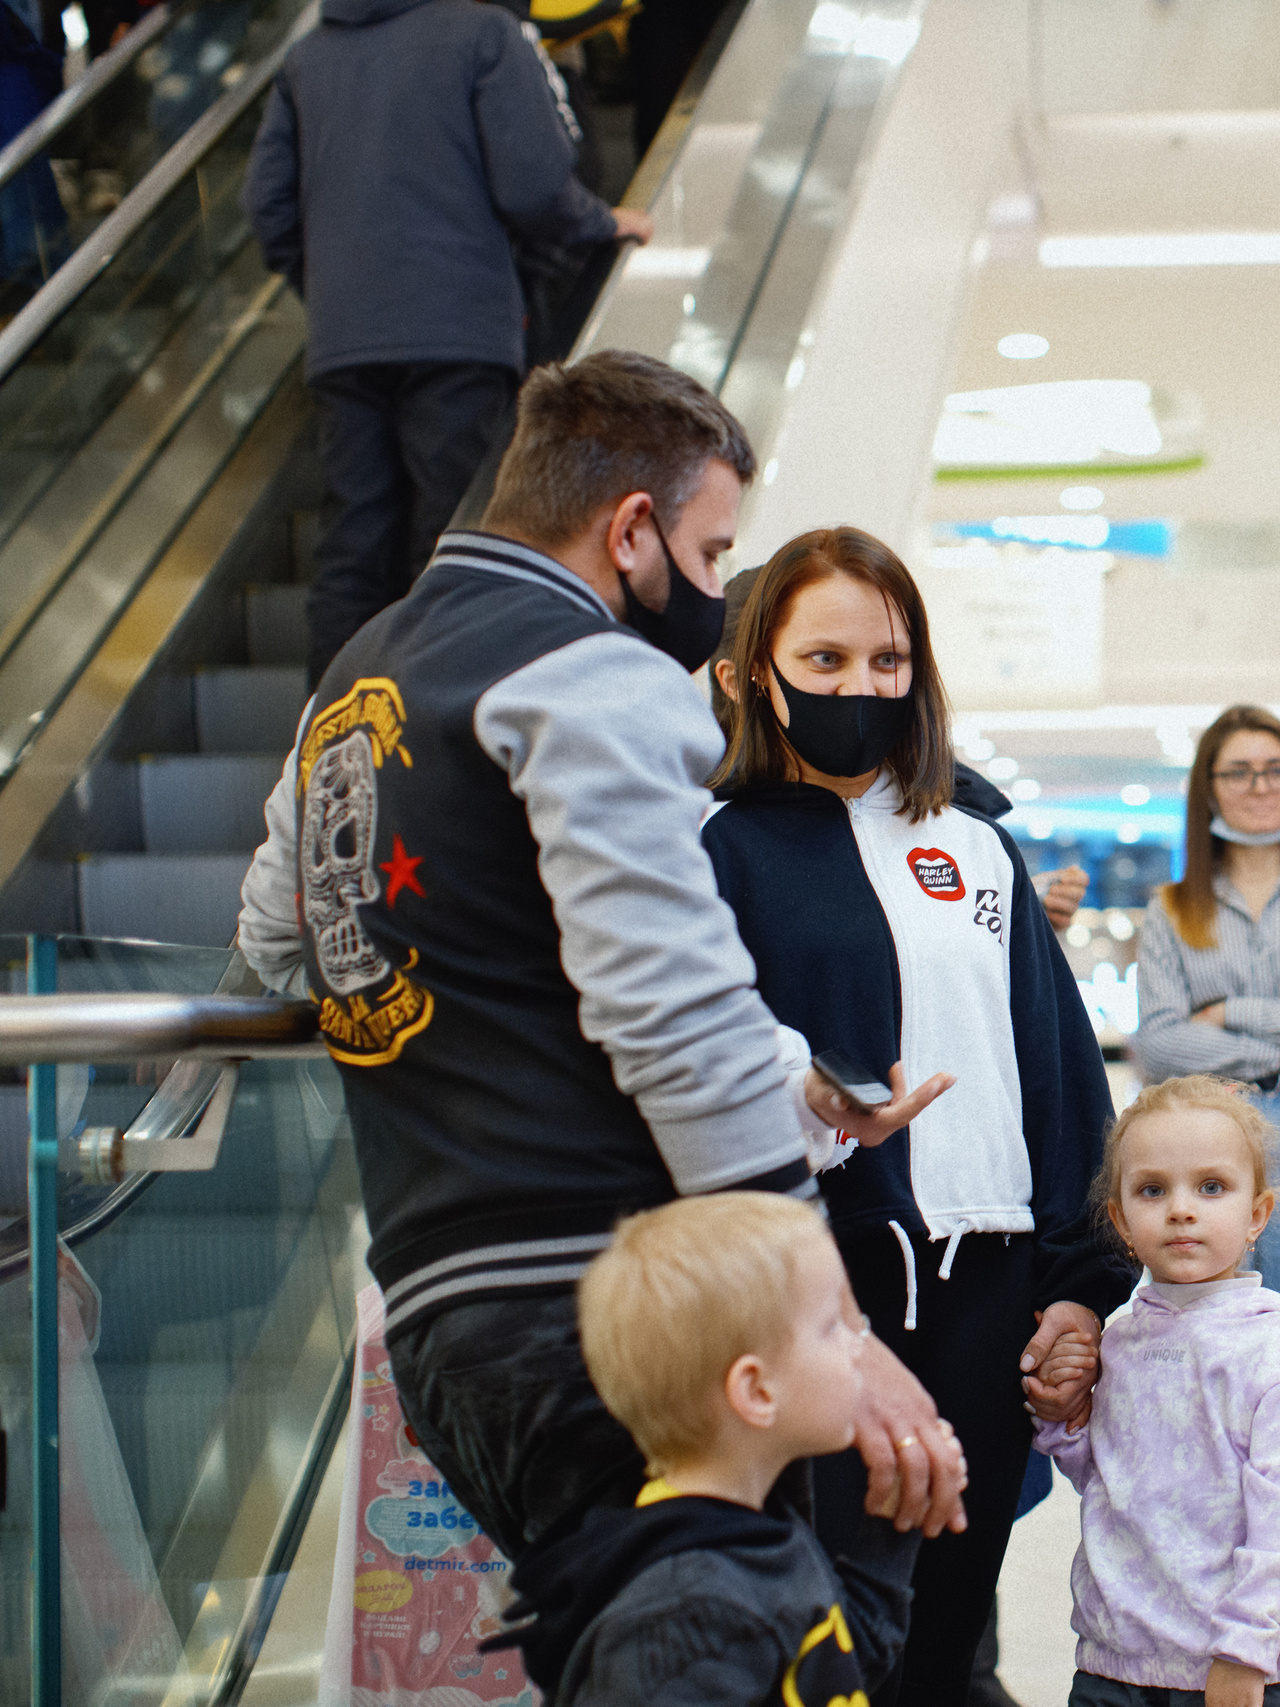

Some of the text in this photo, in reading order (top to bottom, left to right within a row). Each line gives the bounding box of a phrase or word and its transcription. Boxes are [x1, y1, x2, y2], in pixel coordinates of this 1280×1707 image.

[918, 866, 955, 877] HARLEY
[923, 875, 953, 885] QUINN
[1143, 1348, 1186, 1363] UNIQUE
[404, 1556, 507, 1573] detmir.com
